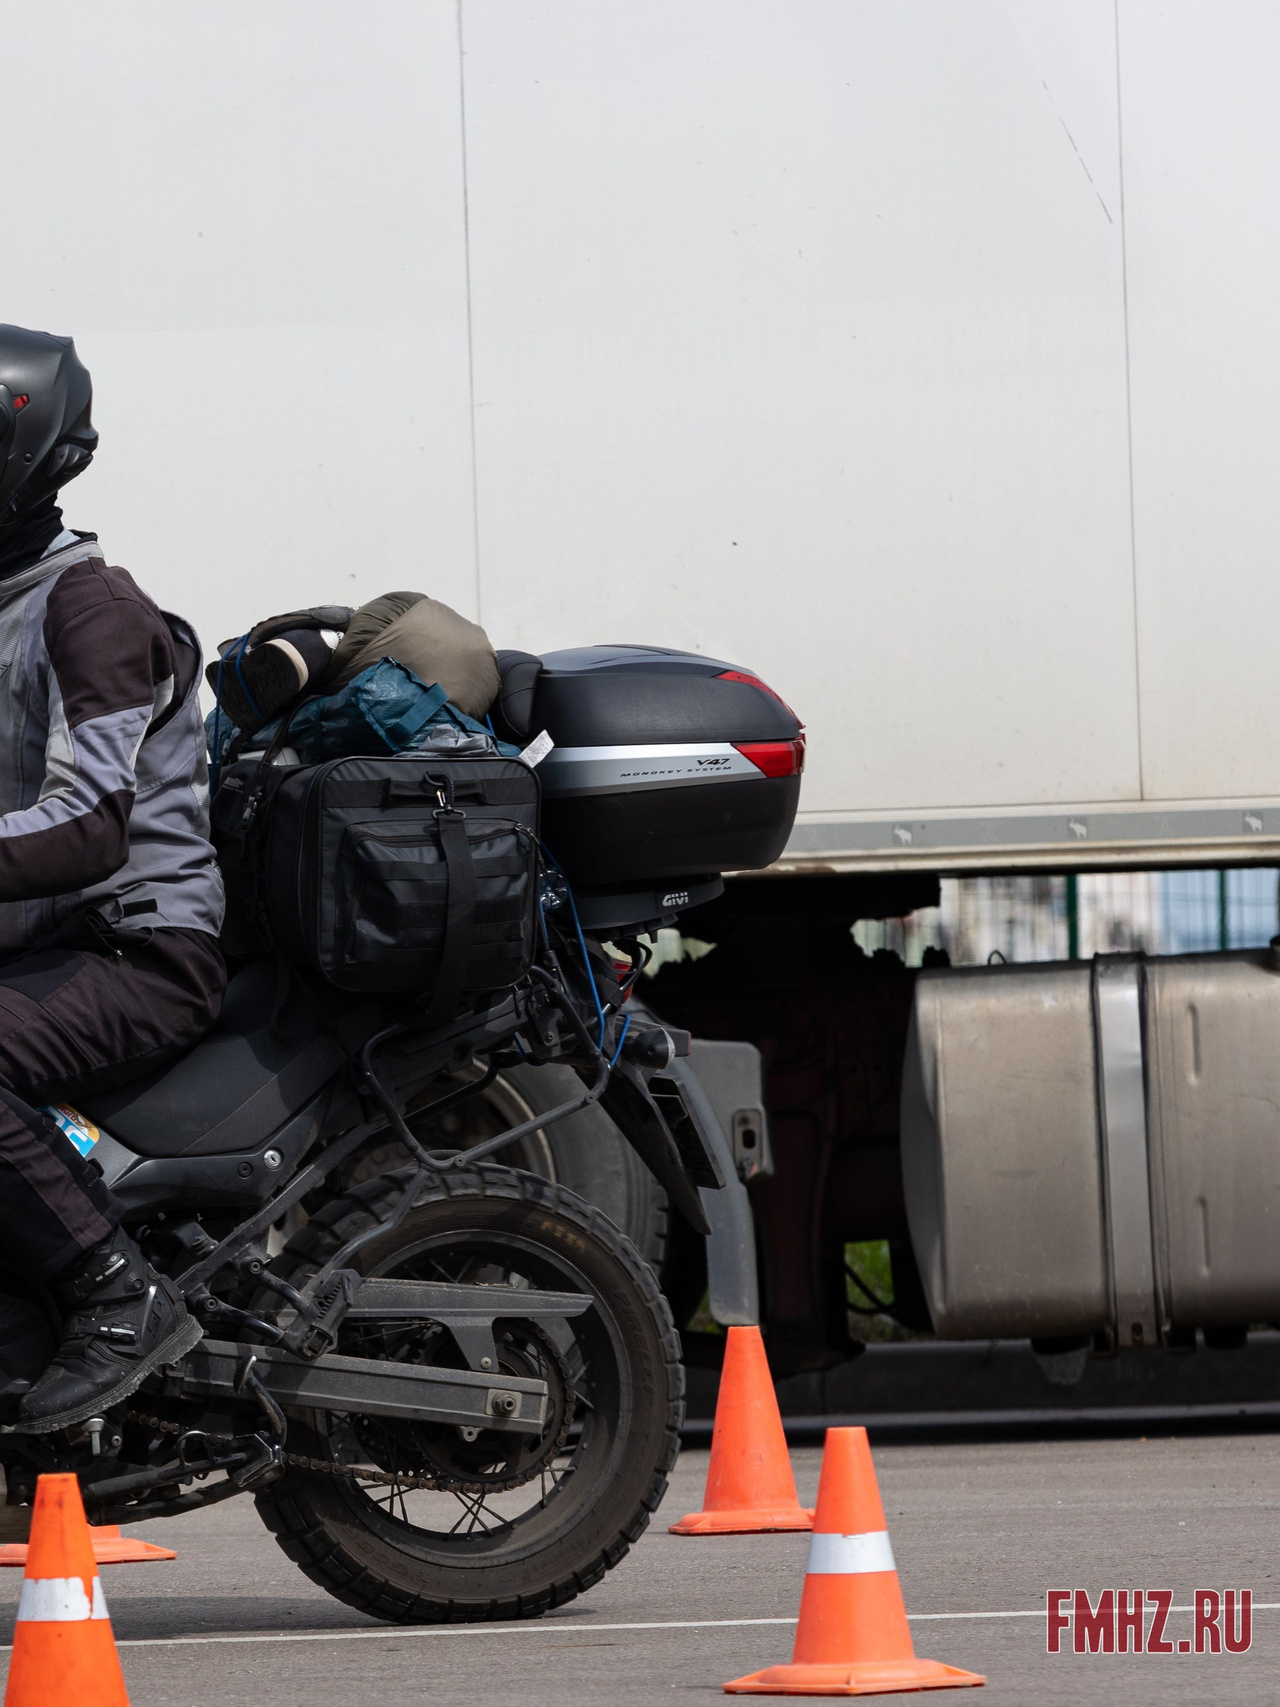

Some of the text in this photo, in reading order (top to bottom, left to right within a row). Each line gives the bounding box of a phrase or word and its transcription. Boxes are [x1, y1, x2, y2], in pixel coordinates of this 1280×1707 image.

[697, 758, 730, 766] V47
[620, 769, 682, 777] MONOKEY
[662, 891, 689, 906] GIVI
[613, 1290, 655, 1395] PIRELLI
